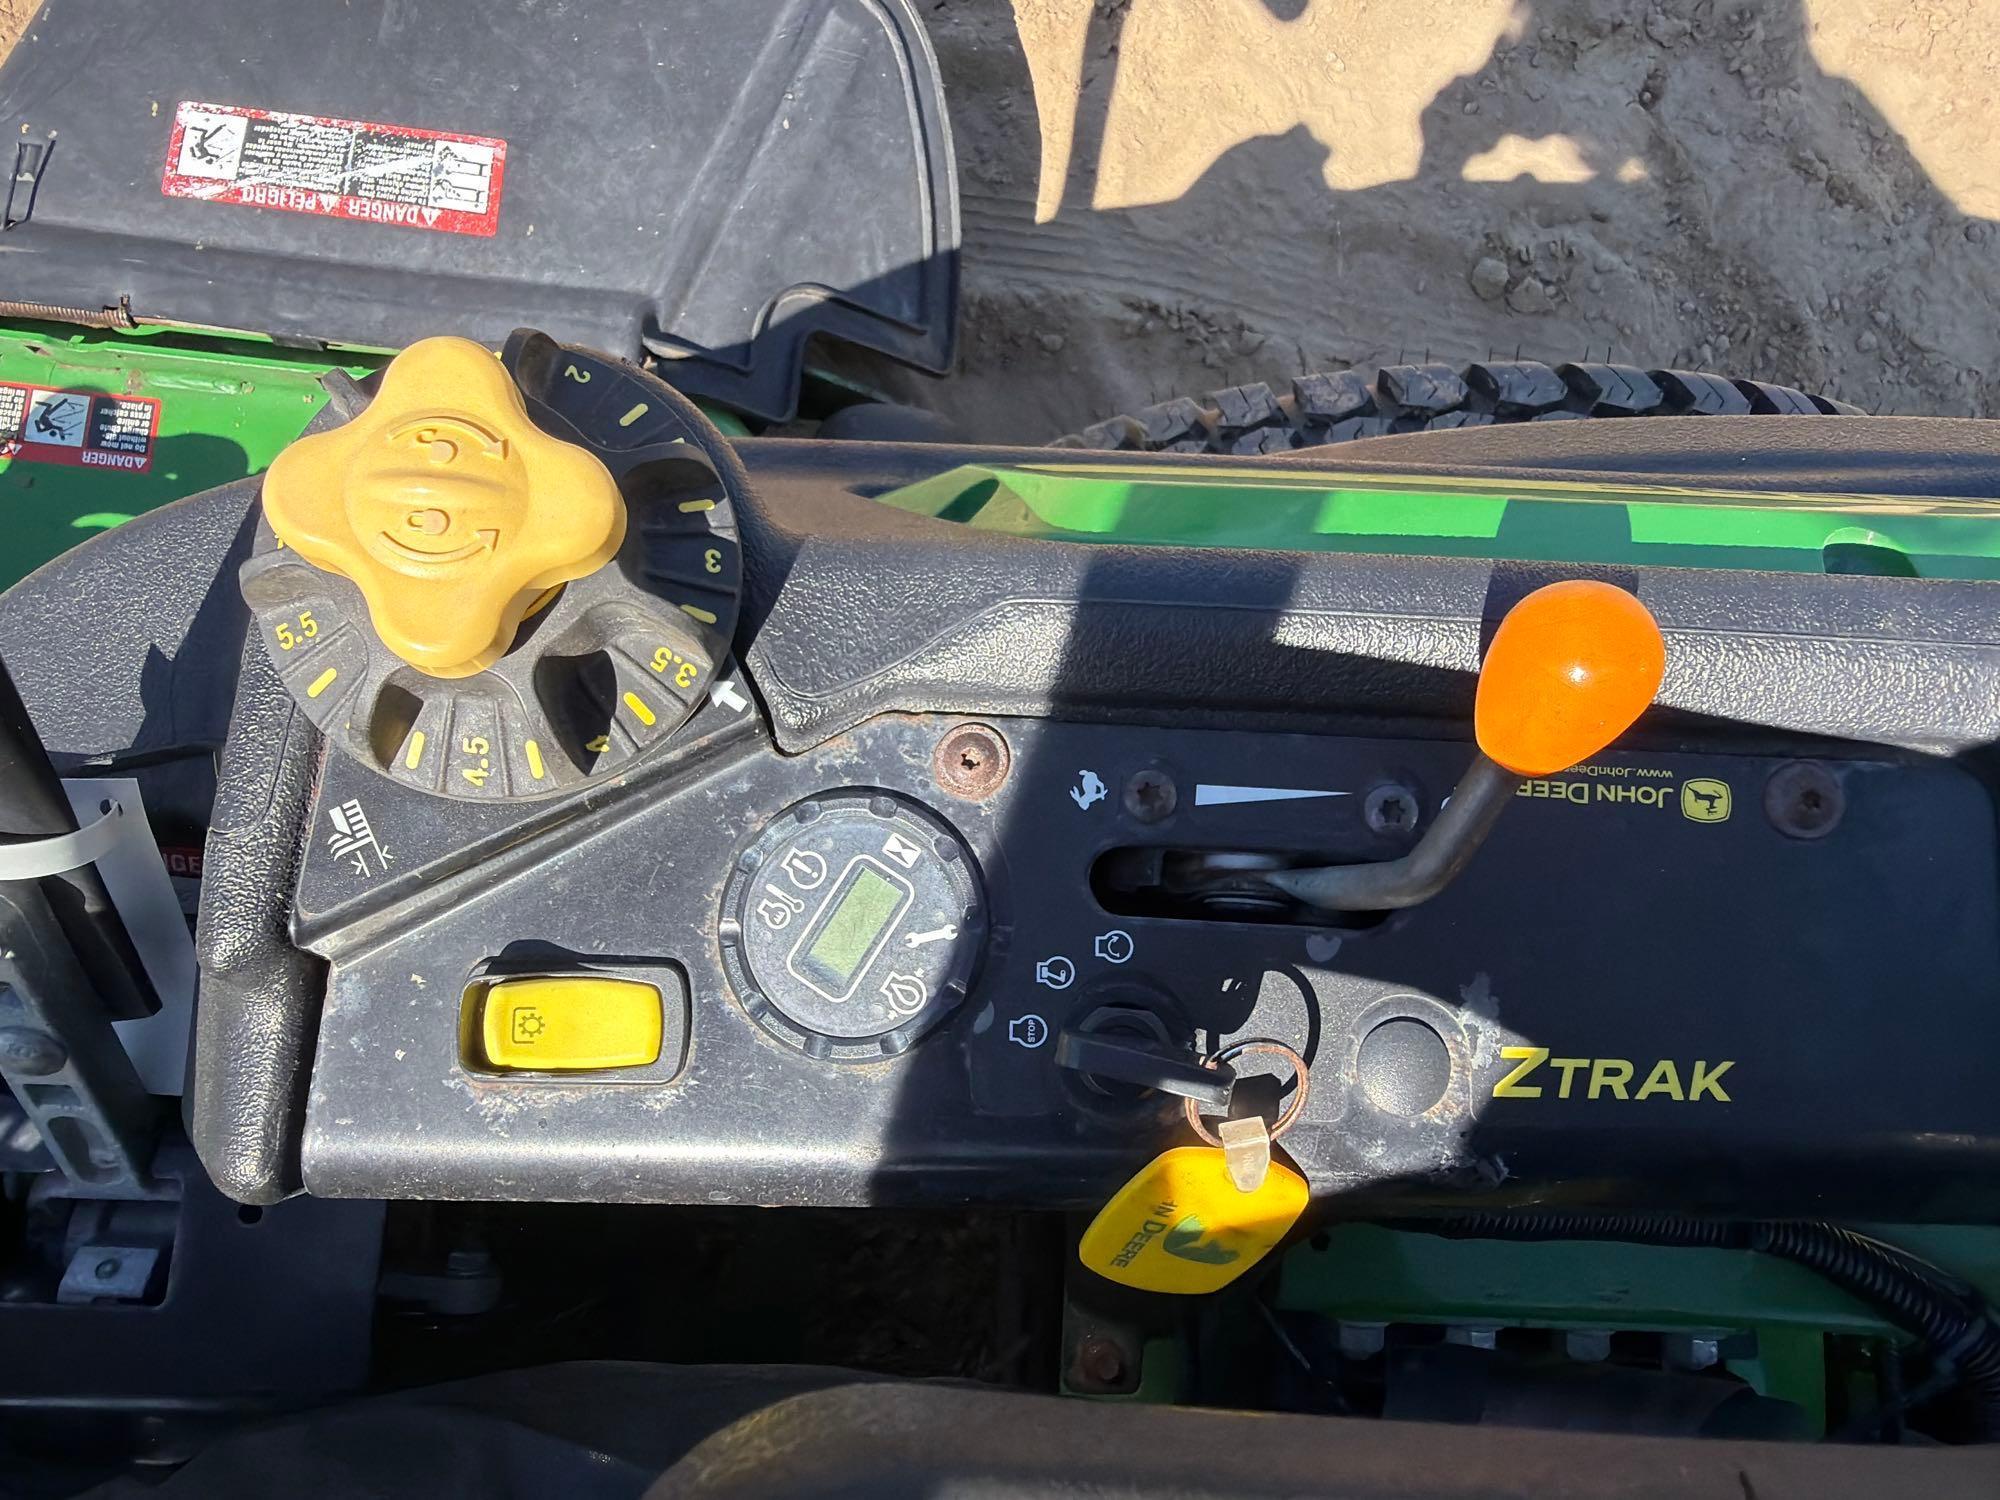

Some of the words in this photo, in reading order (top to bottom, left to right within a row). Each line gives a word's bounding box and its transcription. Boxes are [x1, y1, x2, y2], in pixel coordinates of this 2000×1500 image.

[240, 186, 318, 210] PELIGRO
[347, 197, 420, 225] DANGER
[564, 364, 591, 384] 2
[82, 451, 133, 467] DANGER
[705, 549, 722, 574] 3
[275, 610, 319, 650] 5.5
[650, 647, 698, 688] 3.5
[462, 736, 490, 788] 4.5
[1596, 784, 1674, 809] JOHN
[1027, 1019, 1035, 1042] STOP
[1492, 1046, 1737, 1103] ZTRAK
[1109, 1219, 1168, 1268] DEERE
